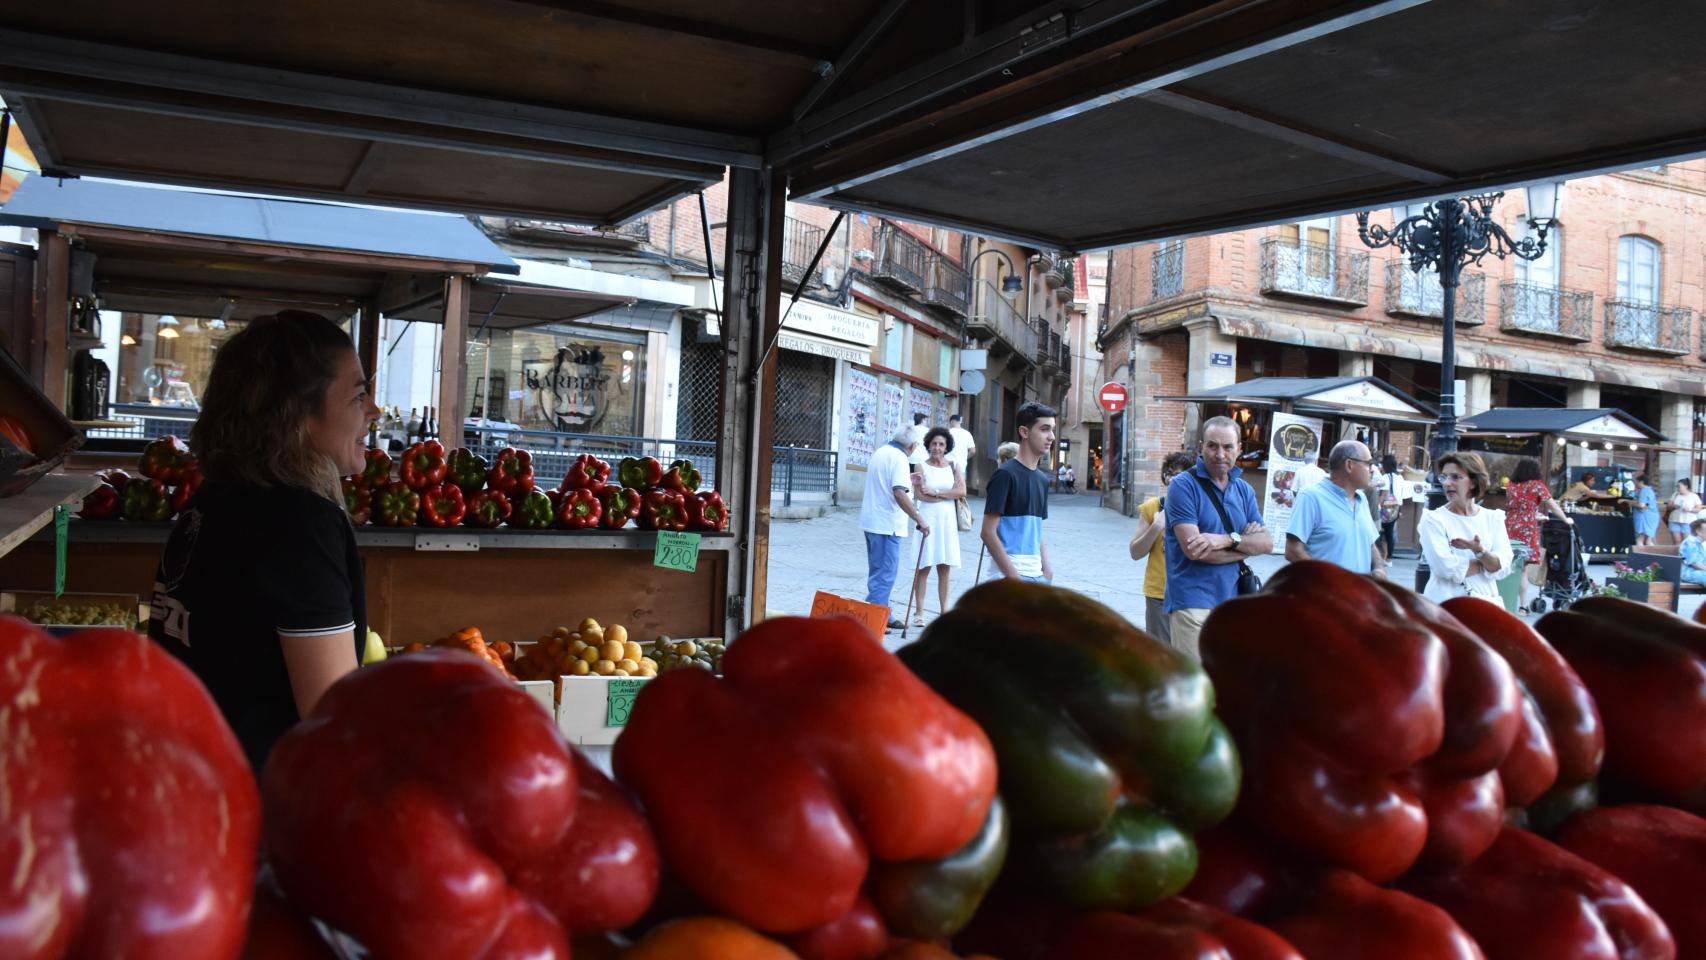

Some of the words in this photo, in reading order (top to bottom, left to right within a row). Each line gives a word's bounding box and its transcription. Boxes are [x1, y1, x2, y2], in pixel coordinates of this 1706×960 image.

[832, 325, 865, 339] REGALOS
[779, 338, 814, 352] REGALOS
[821, 346, 863, 363] DROGUERIA
[659, 546, 692, 566] 2'80
